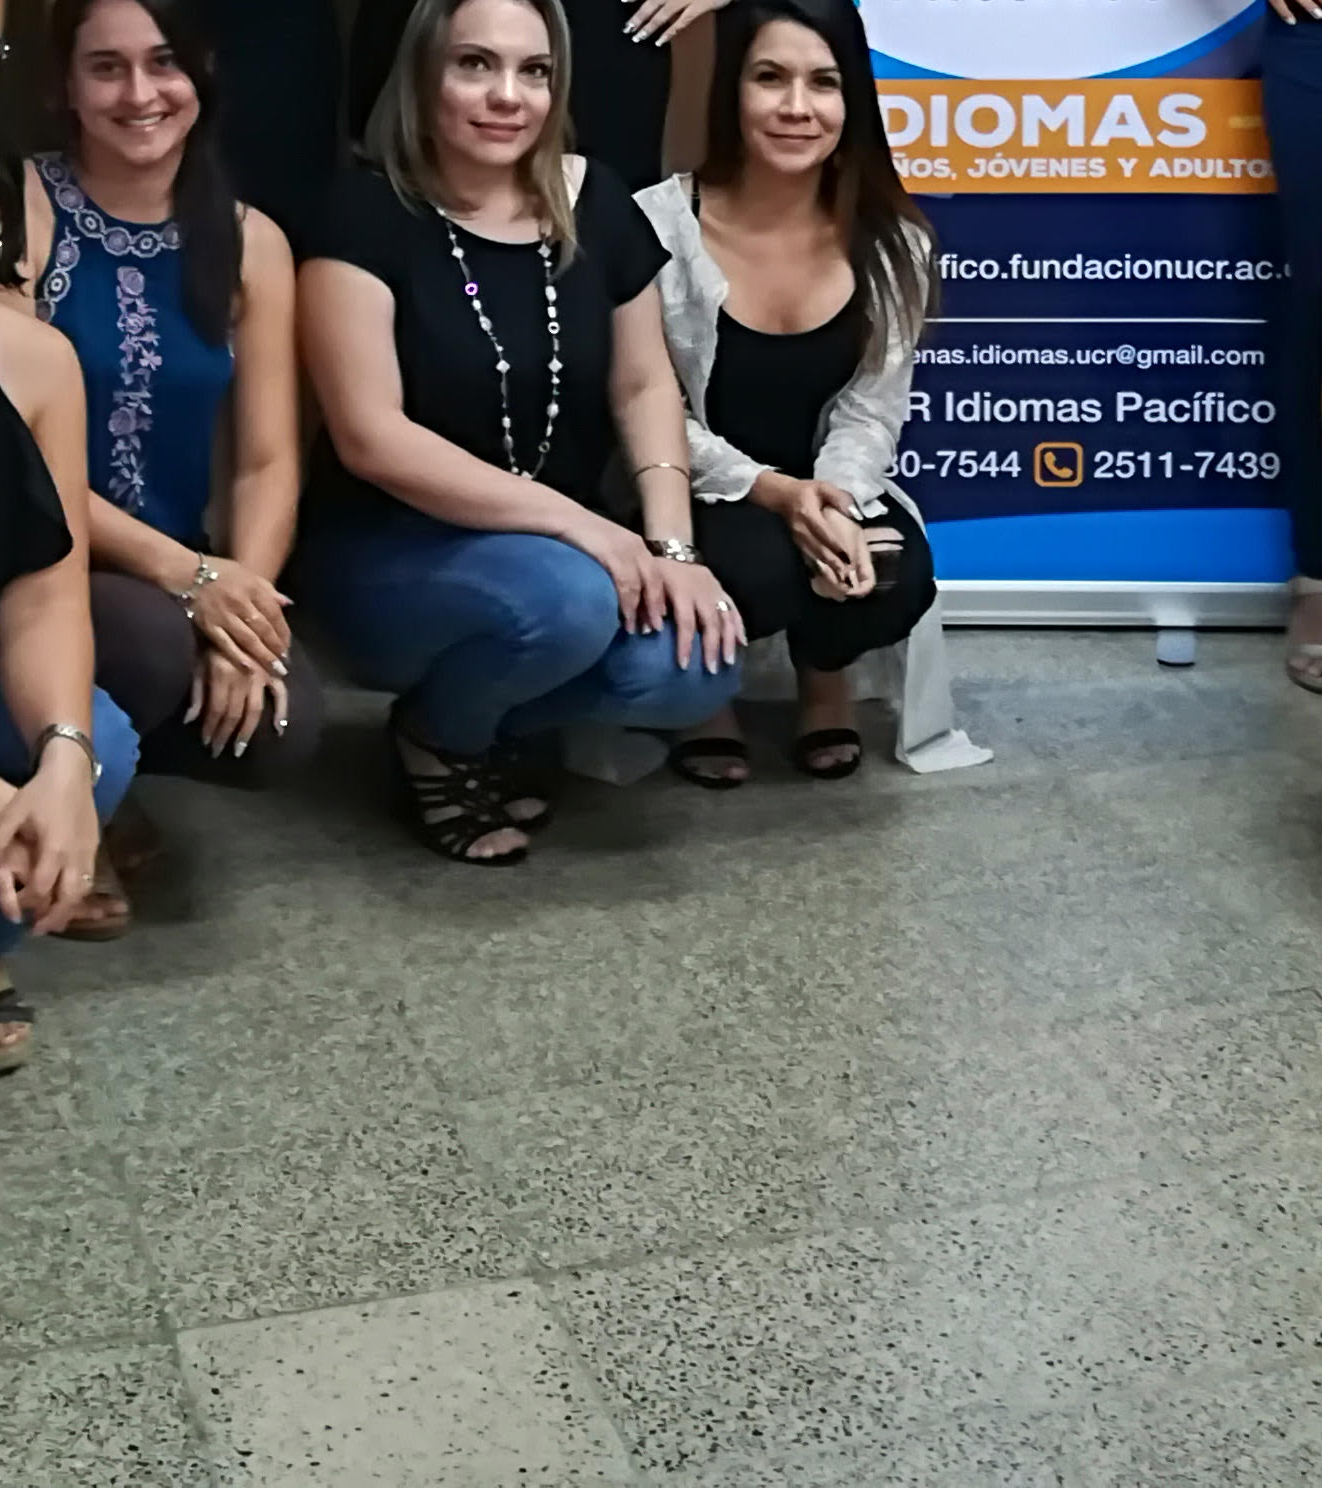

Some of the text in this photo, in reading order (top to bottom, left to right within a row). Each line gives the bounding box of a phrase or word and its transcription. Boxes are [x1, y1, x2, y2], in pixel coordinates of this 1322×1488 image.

[967, 152, 1107, 179] JÓVENES
[1116, 157, 1139, 178] Y
[1148, 157, 1275, 179] ADULTO
[945, 391, 1102, 423] Idiomas
[1116, 390, 1277, 423] Pacífico
[1093, 450, 1281, 480] 2511-7439
